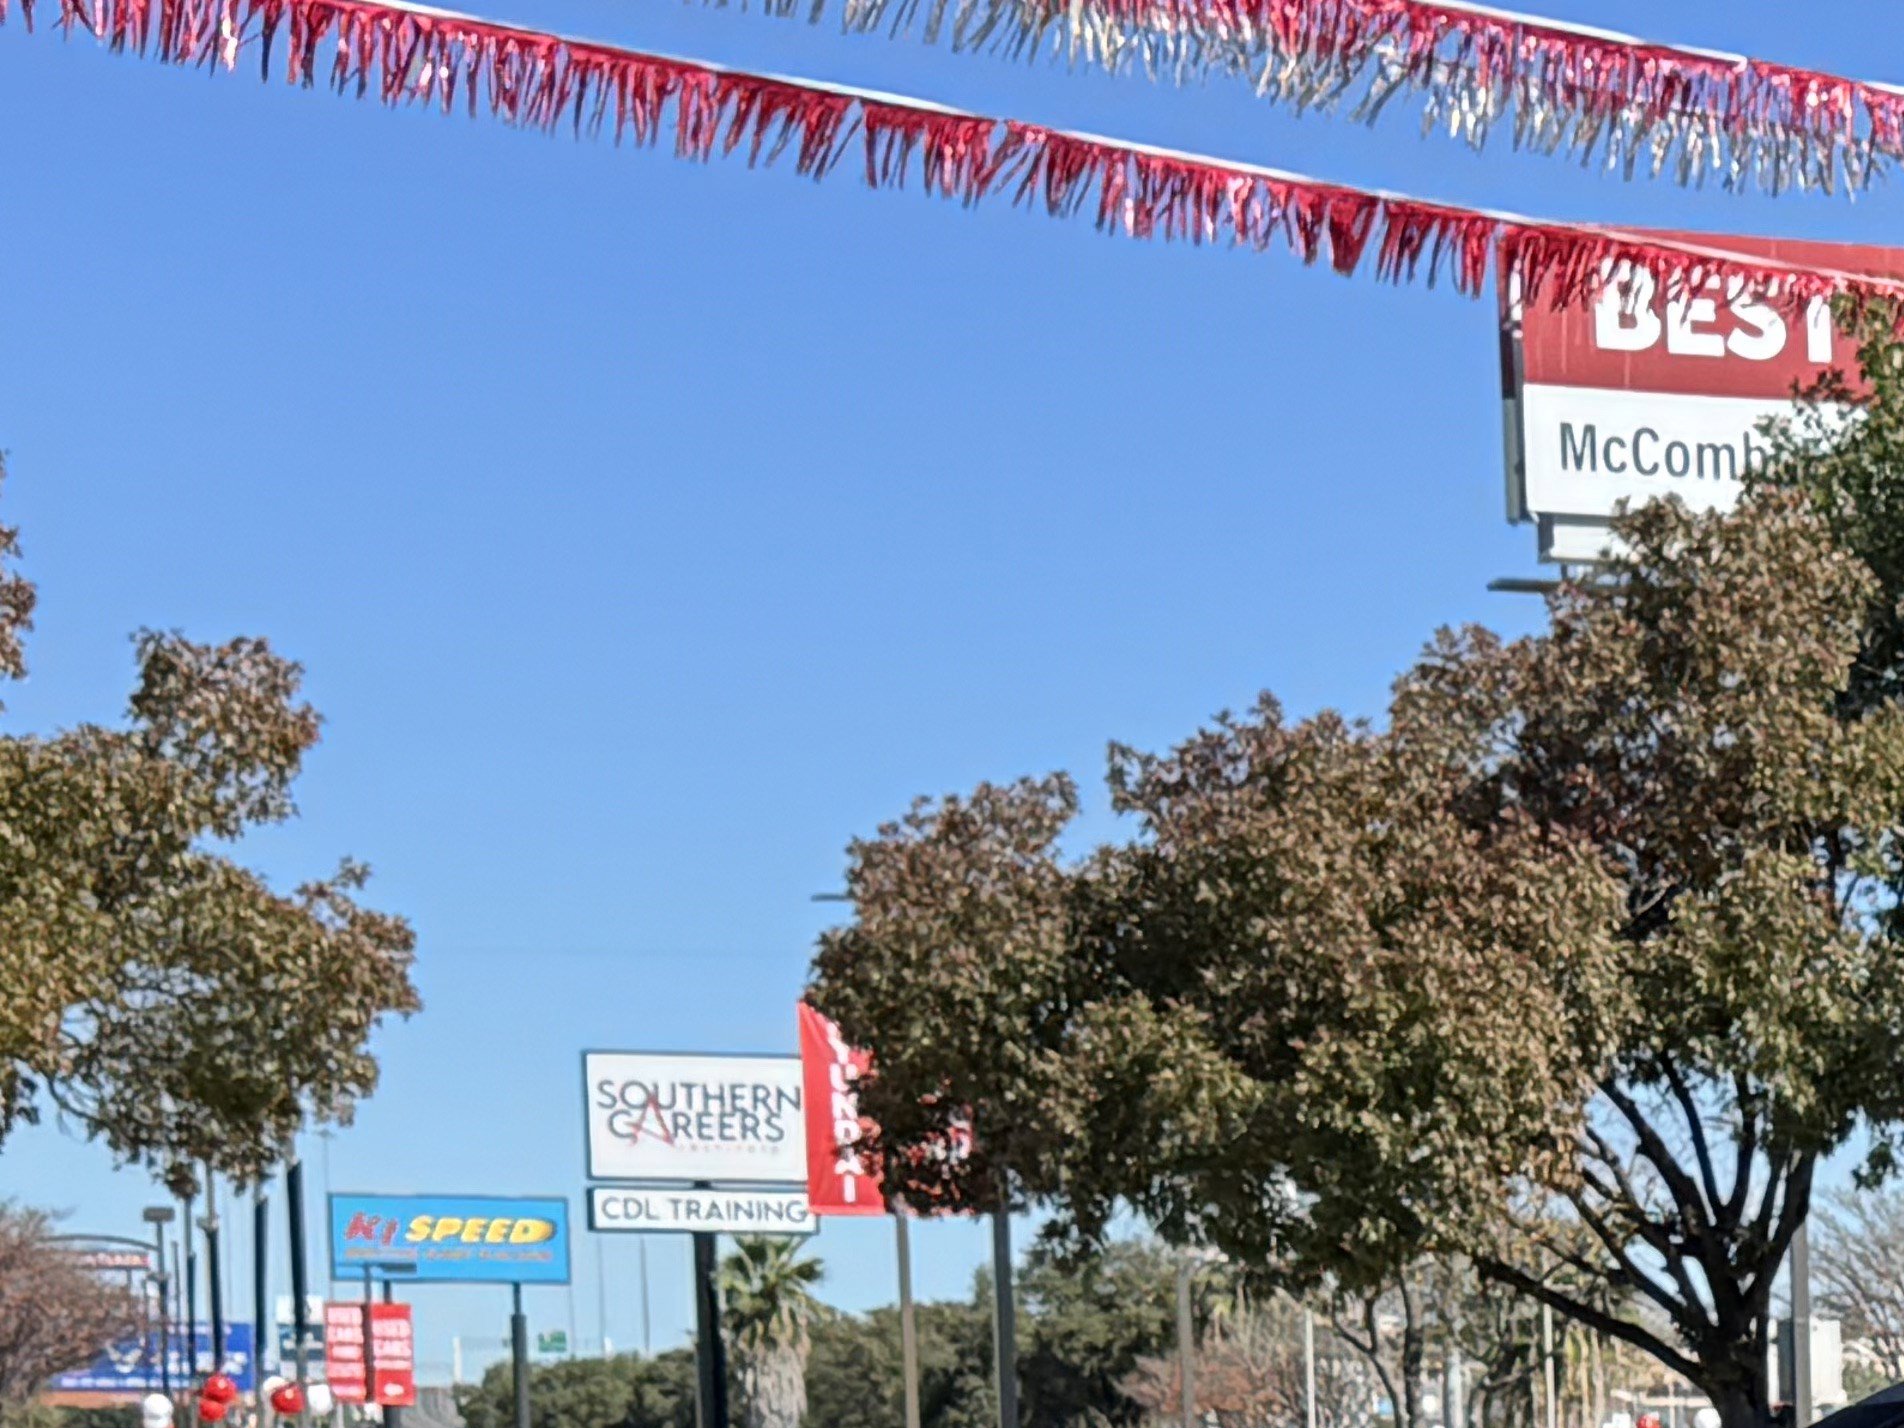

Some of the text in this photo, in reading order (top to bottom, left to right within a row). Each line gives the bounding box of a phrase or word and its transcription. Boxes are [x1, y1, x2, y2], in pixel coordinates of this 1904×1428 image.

[1594, 257, 1833, 364] BEST
[1559, 422, 1766, 480] McComb
[596, 1079, 801, 1112] SOUTHERN
[608, 1098, 785, 1146] CAREERS
[405, 1215, 555, 1245] SPEED
[601, 1197, 808, 1223] CDL TRAINING
